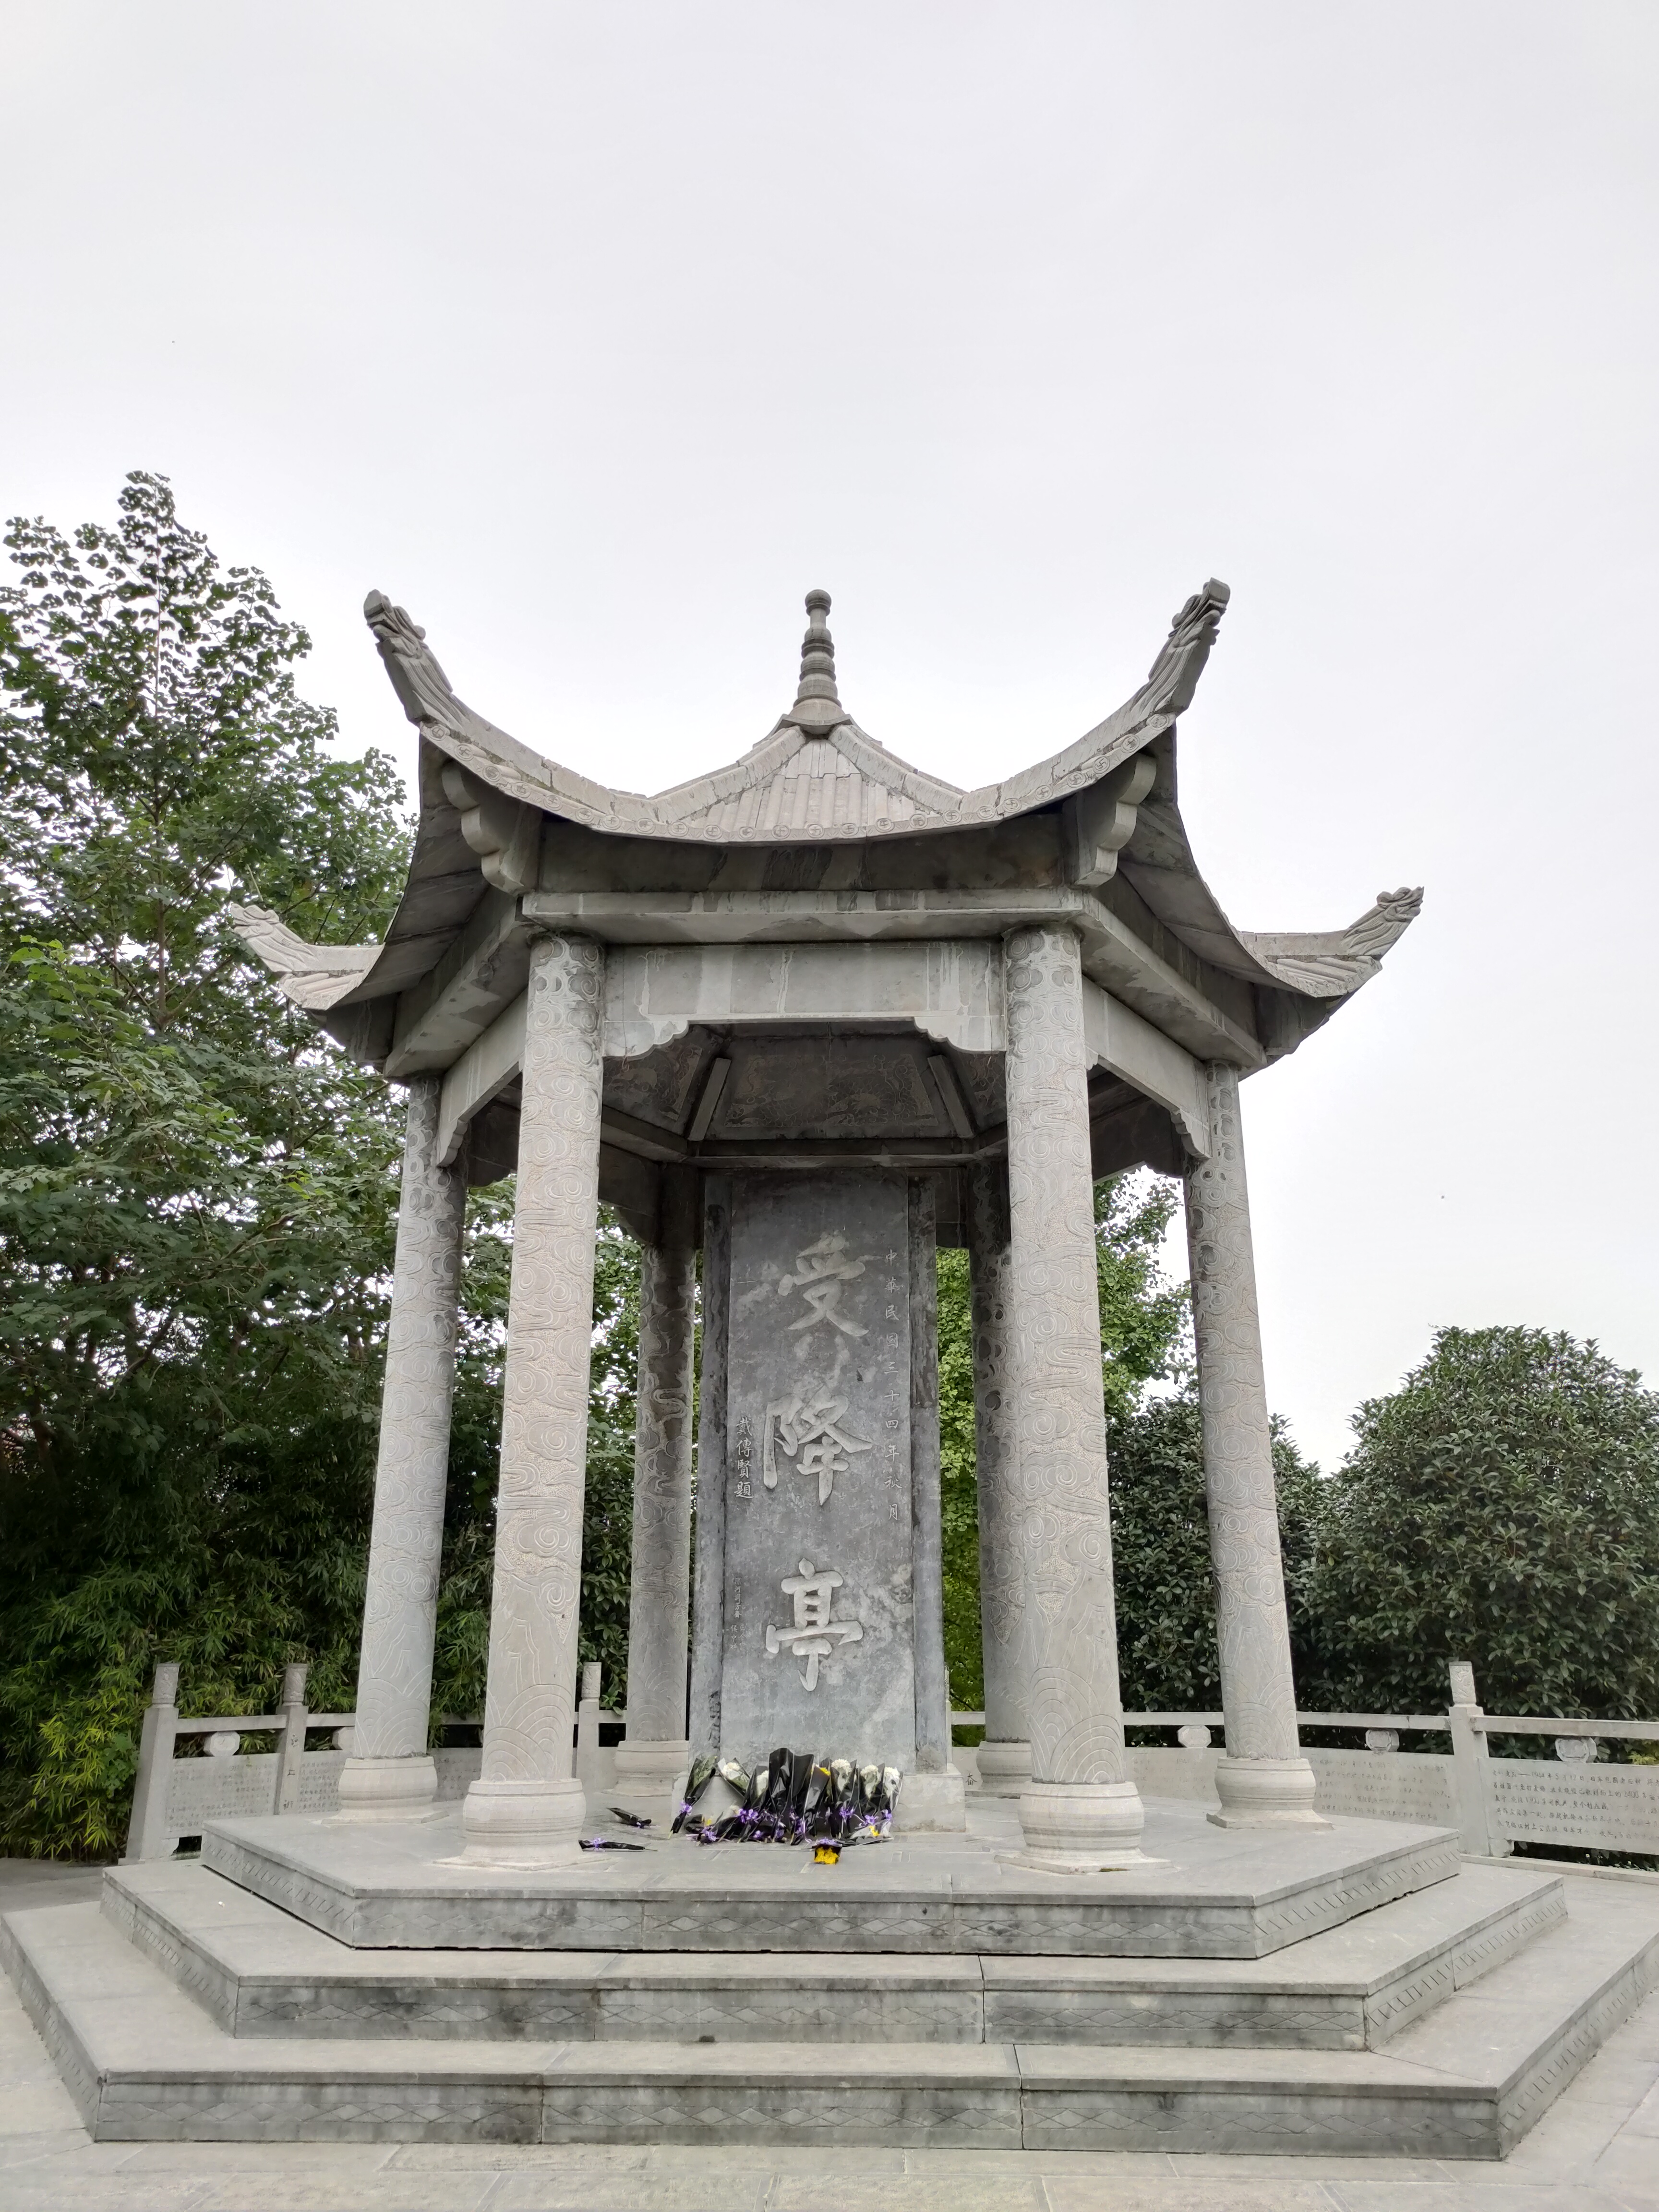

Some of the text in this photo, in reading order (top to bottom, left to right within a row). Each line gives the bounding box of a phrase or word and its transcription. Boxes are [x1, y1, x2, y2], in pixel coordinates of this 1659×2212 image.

[734, 1417, 754, 1498] 戴傳賢題
[763, 1232, 872, 1691] 受降亭
[884, 1249, 902, 1521] 中華民國三十四年秋月
